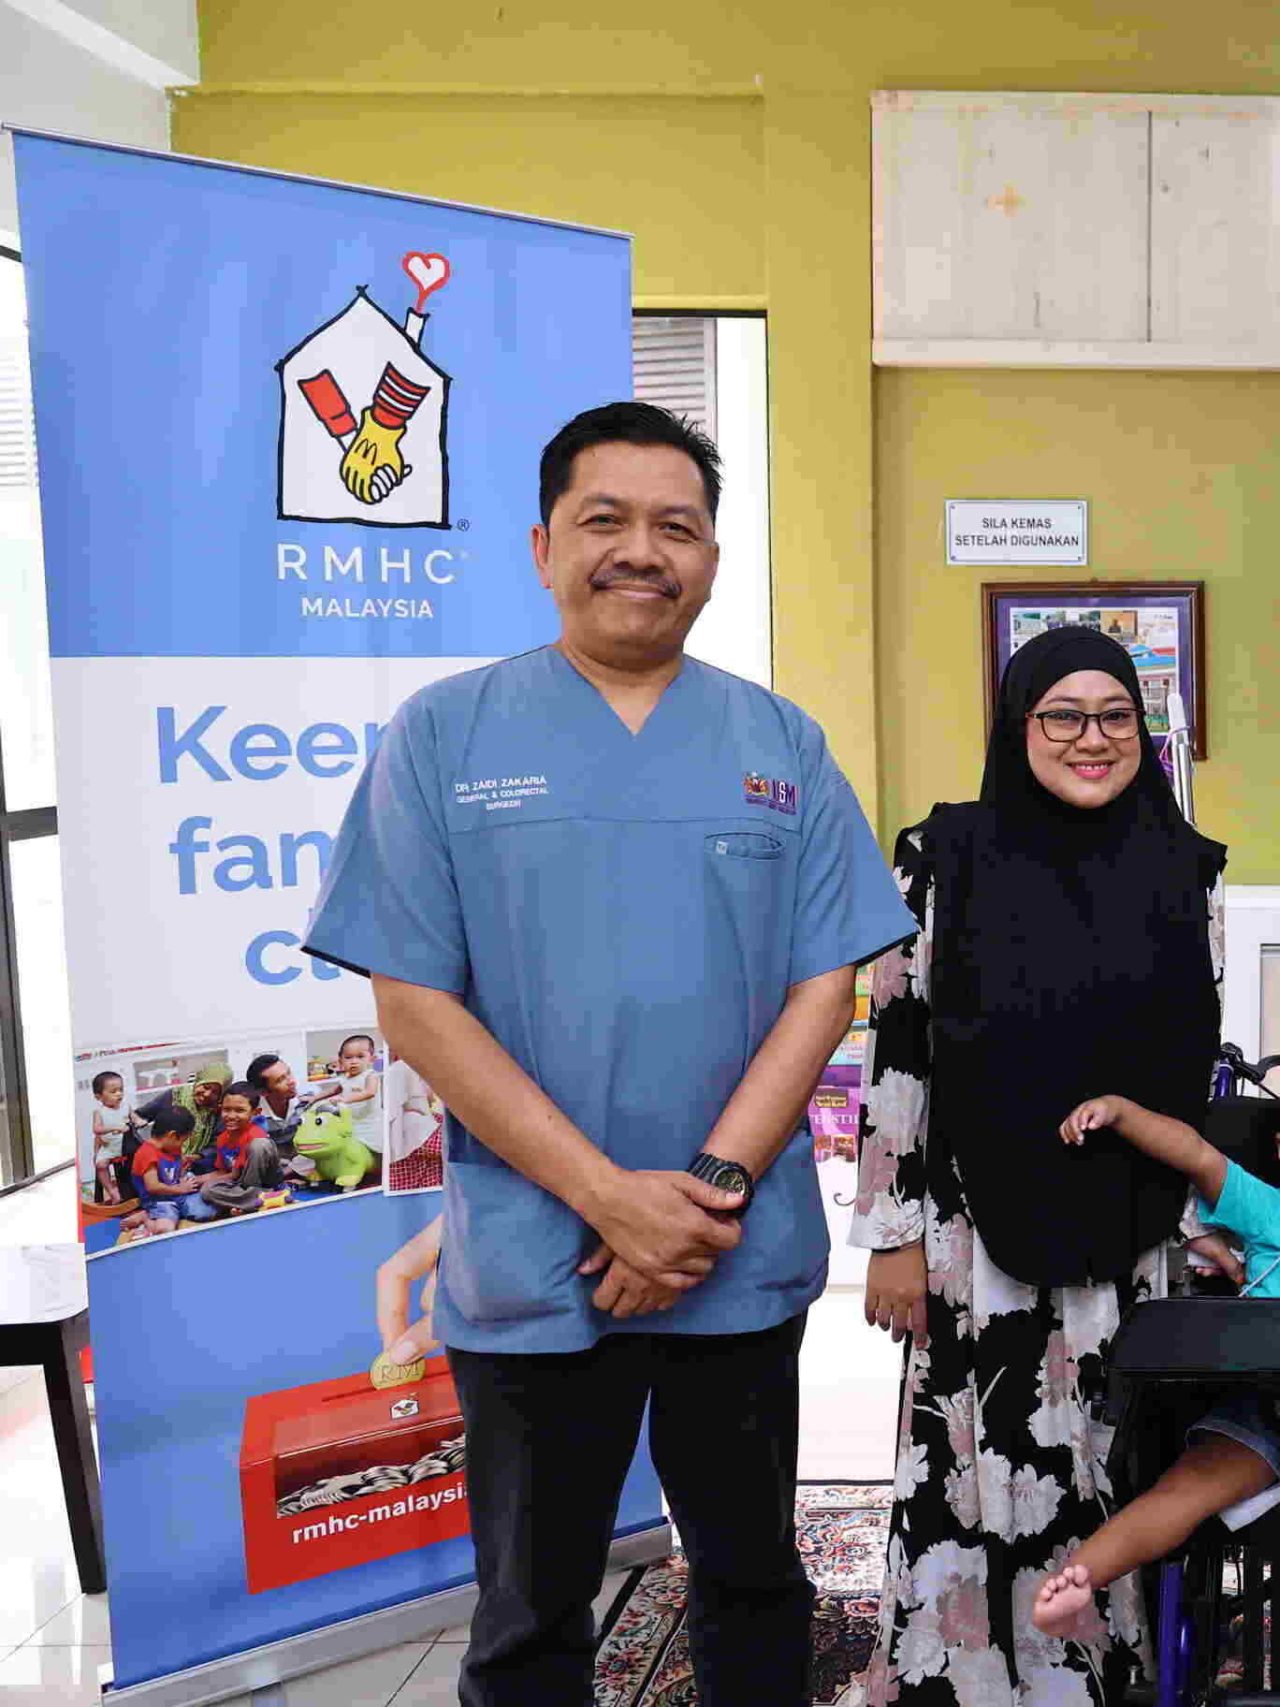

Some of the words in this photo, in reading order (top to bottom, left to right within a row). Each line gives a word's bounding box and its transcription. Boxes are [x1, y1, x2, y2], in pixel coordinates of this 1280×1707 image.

[982, 517, 1008, 529] SILA
[1011, 517, 1052, 529] KEMAS
[955, 534, 1007, 546] SETELAH
[1011, 534, 1079, 546] DIGUNAKAN
[277, 543, 455, 584] RMHC
[302, 596, 434, 619] MALAYSIA
[501, 775, 547, 787] ZAKARIA
[292, 1482, 467, 1544] rmhc-malaysi
